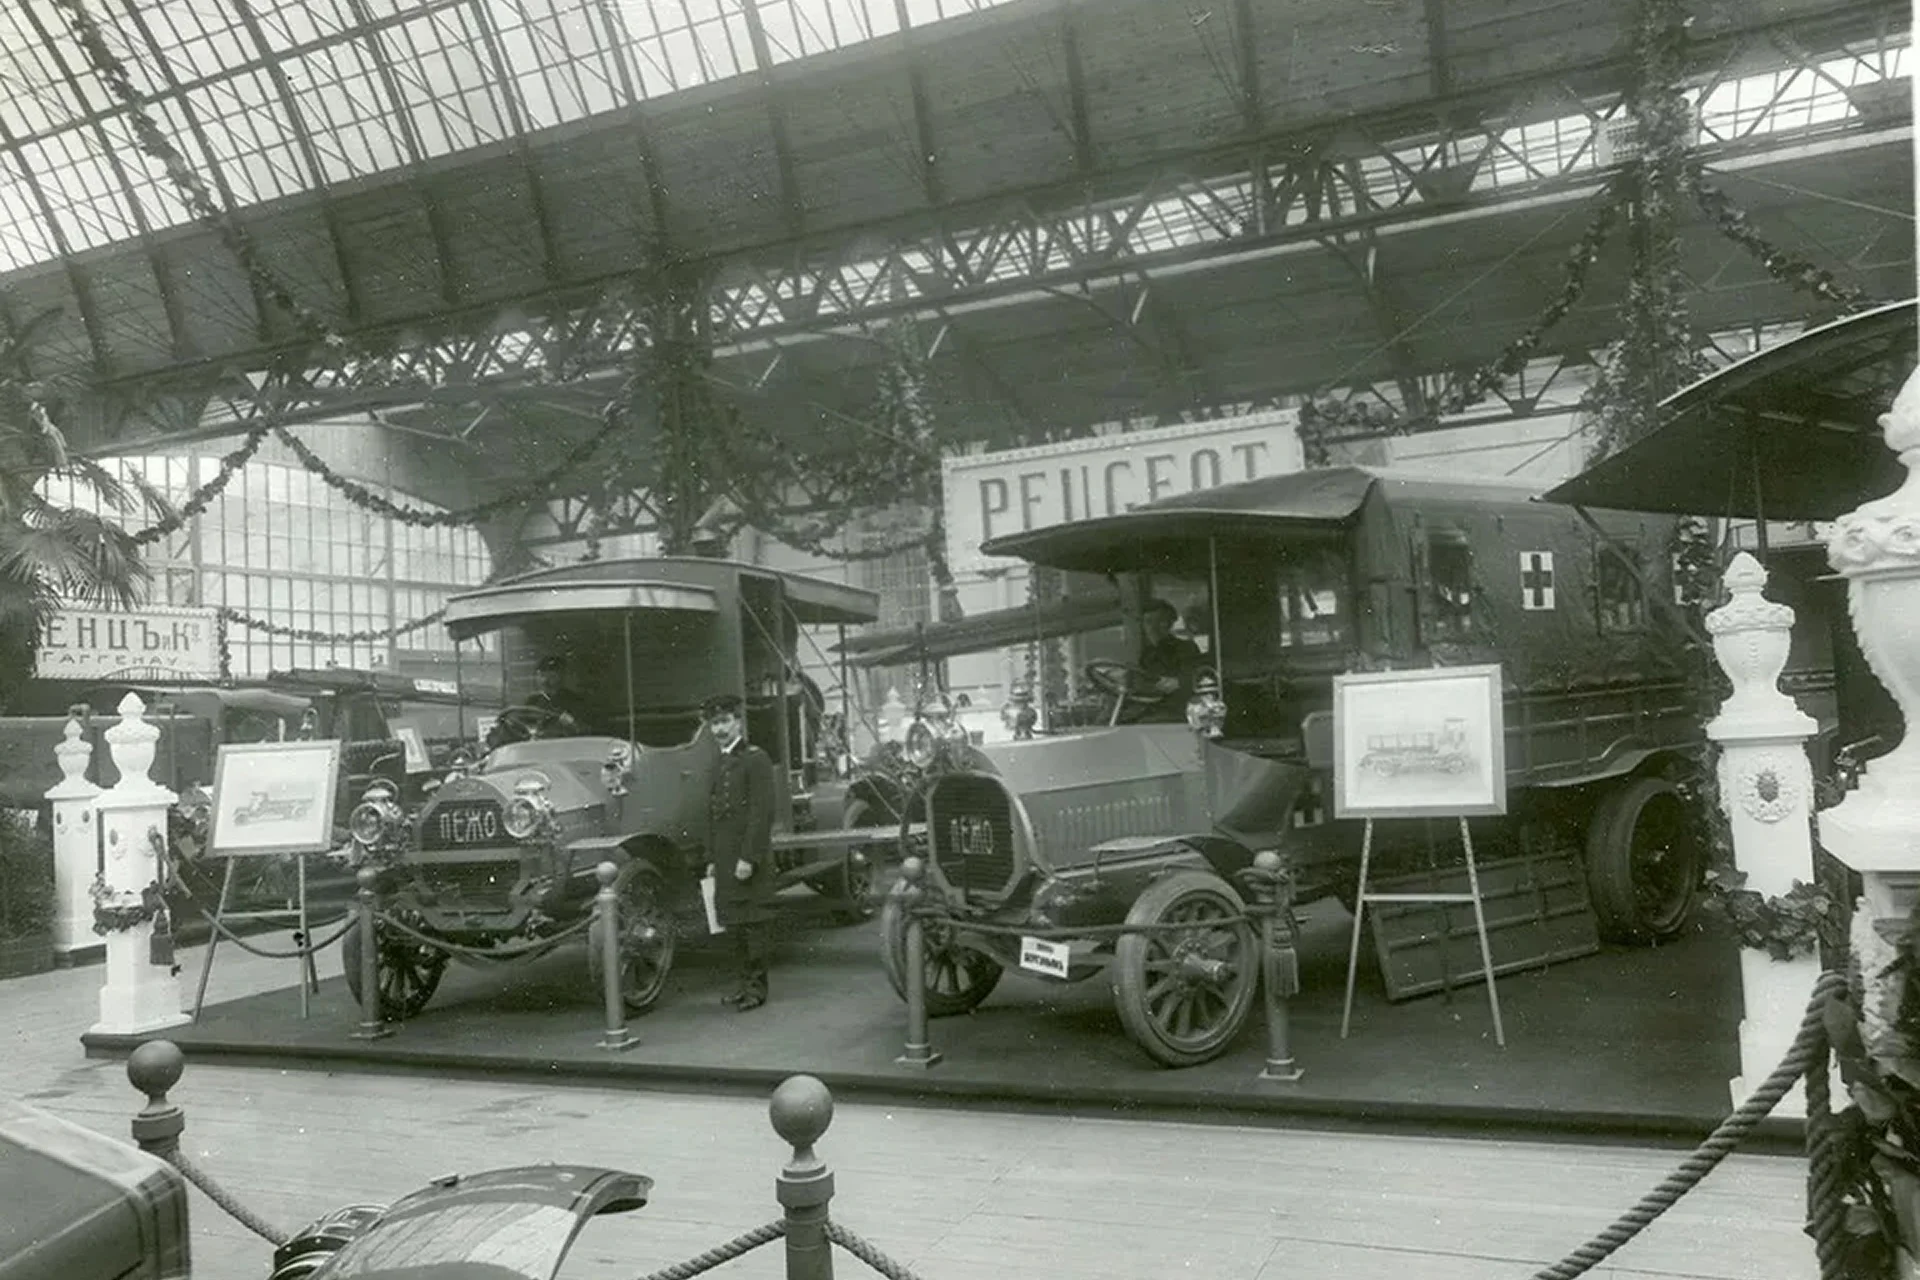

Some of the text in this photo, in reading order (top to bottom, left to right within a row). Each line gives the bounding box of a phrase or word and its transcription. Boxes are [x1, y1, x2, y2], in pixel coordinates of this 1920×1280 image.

[979, 441, 1268, 540] PEUGEOT
[46, 616, 160, 651] ЕНЦЪ
[42, 651, 179, 666] ГАГГЕНАУ
[439, 809, 497, 842] ПЕЖО
